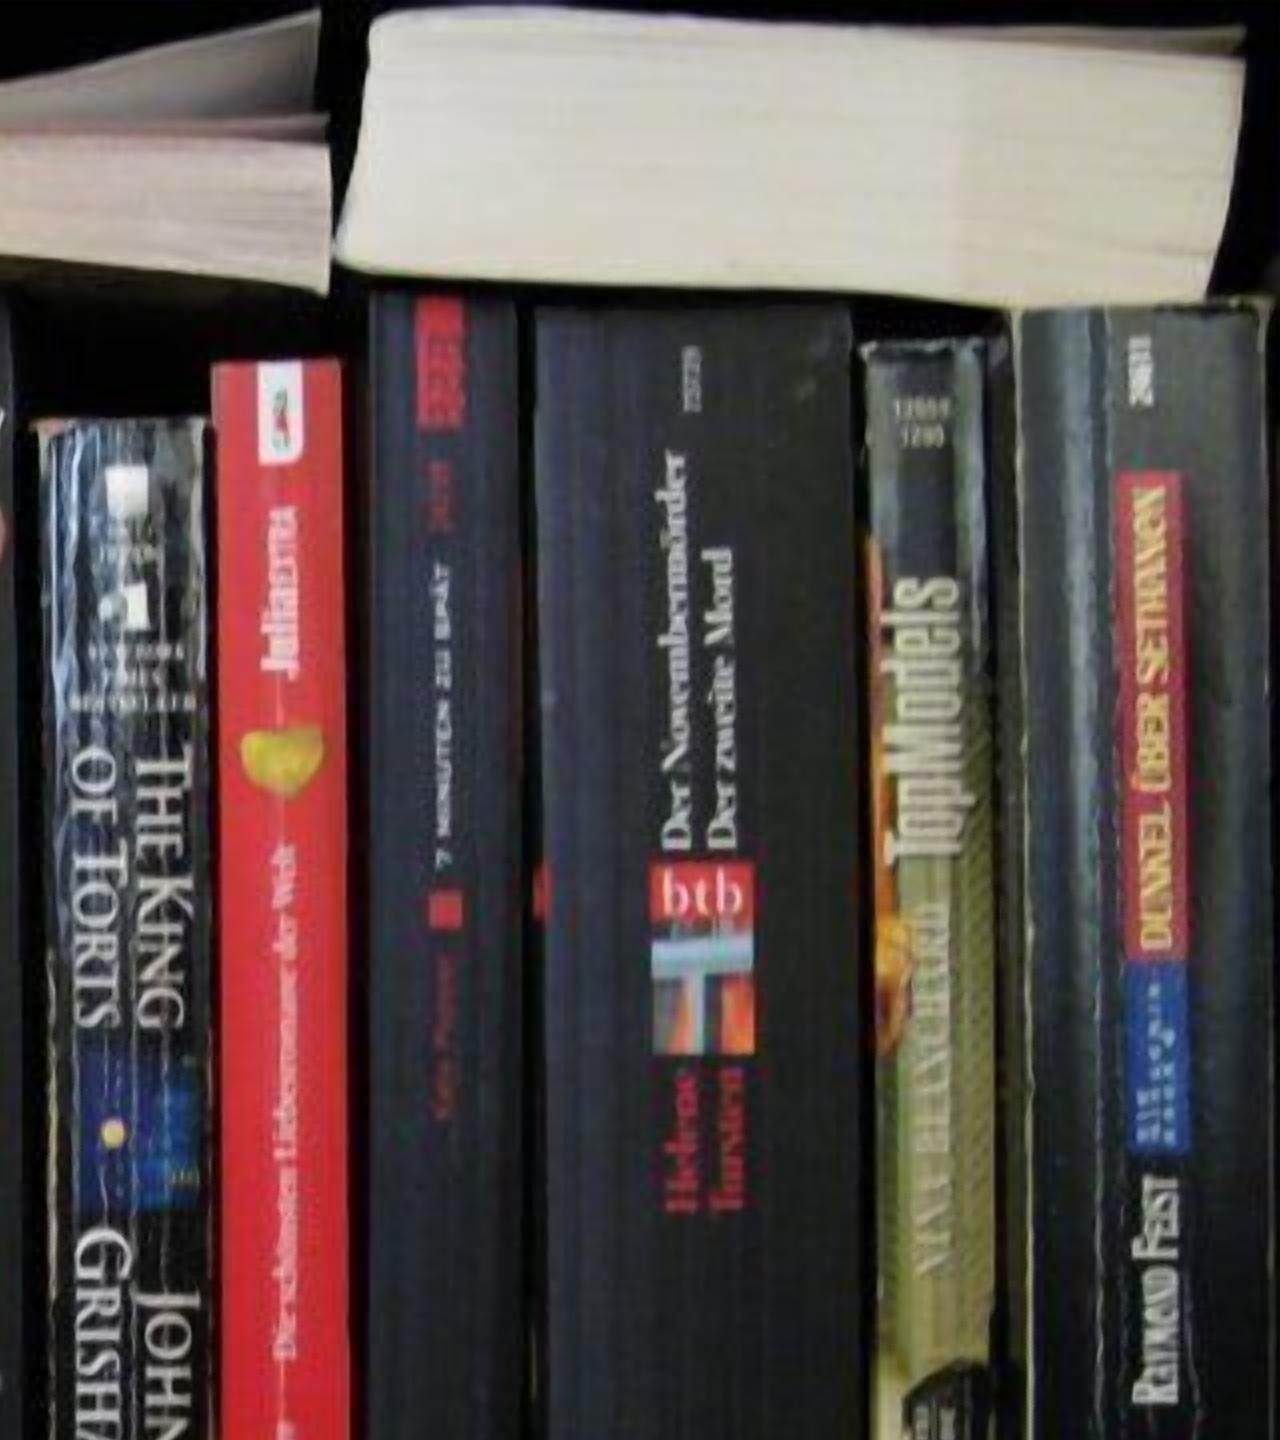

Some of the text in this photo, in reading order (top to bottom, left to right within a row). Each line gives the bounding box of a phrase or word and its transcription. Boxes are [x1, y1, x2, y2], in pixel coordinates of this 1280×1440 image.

[701, 547, 733, 647] Mord
[136, 744, 193, 855] THE
[662, 784, 692, 850] Der
[706, 781, 738, 850] Der
[70, 745, 126, 1030] OF TORTS
[662, 868, 743, 913] btb
[134, 875, 193, 1030] KING
[1131, 1174, 1180, 1404] RAYMOND FEIST
